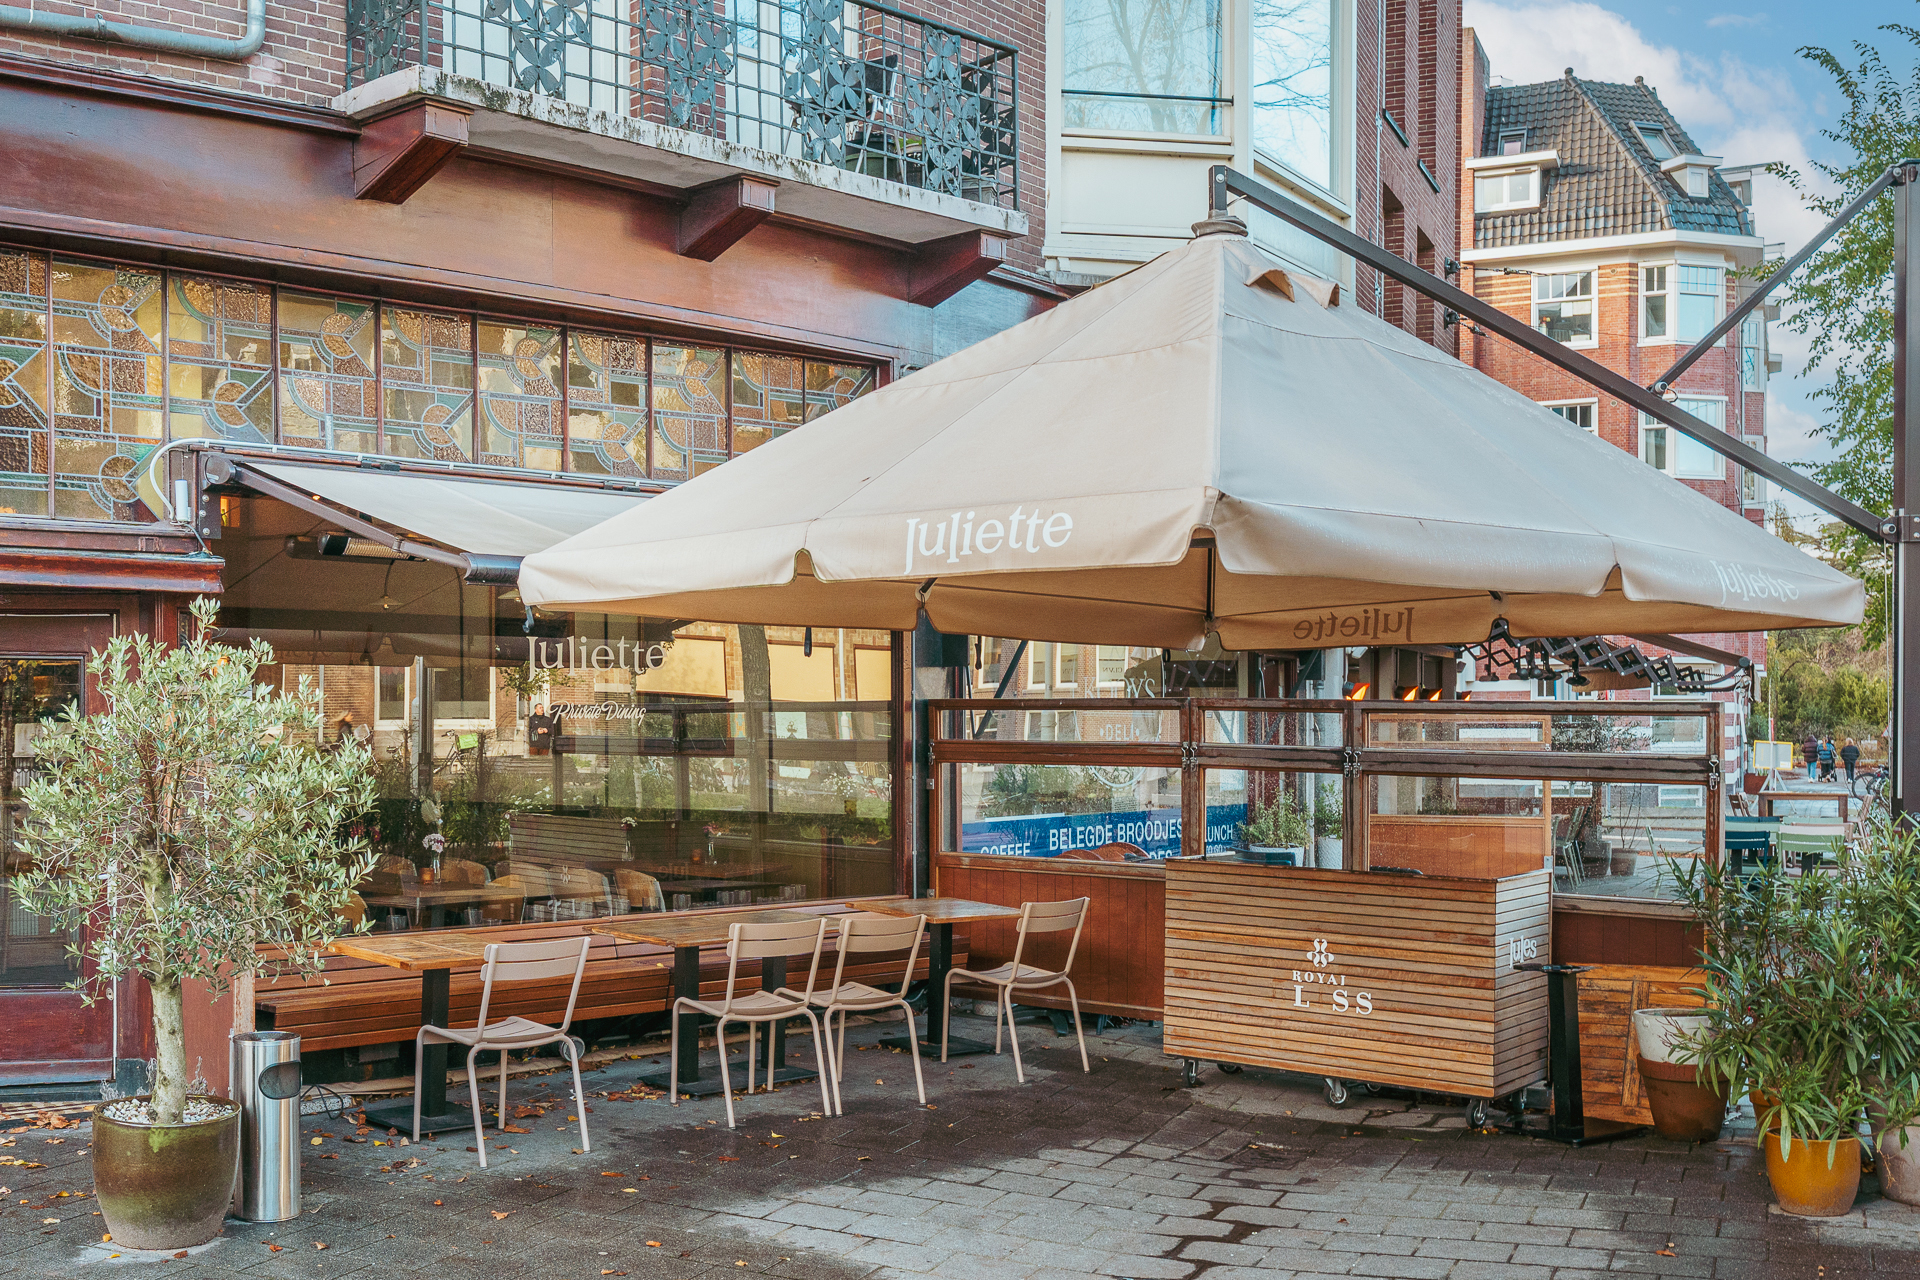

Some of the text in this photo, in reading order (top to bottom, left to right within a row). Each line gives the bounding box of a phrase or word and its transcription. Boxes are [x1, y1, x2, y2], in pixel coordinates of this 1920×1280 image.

[903, 505, 1074, 575] Juliette
[1709, 560, 1799, 605] Juliette
[526, 635, 668, 682] Juliette
[548, 700, 647, 726] Private Dining
[1105, 723, 1134, 741] DELI
[1049, 818, 1182, 851] BELEGDE BROODJES
[1205, 824, 1233, 842] UNCH
[1509, 935, 1537, 969] Jules
